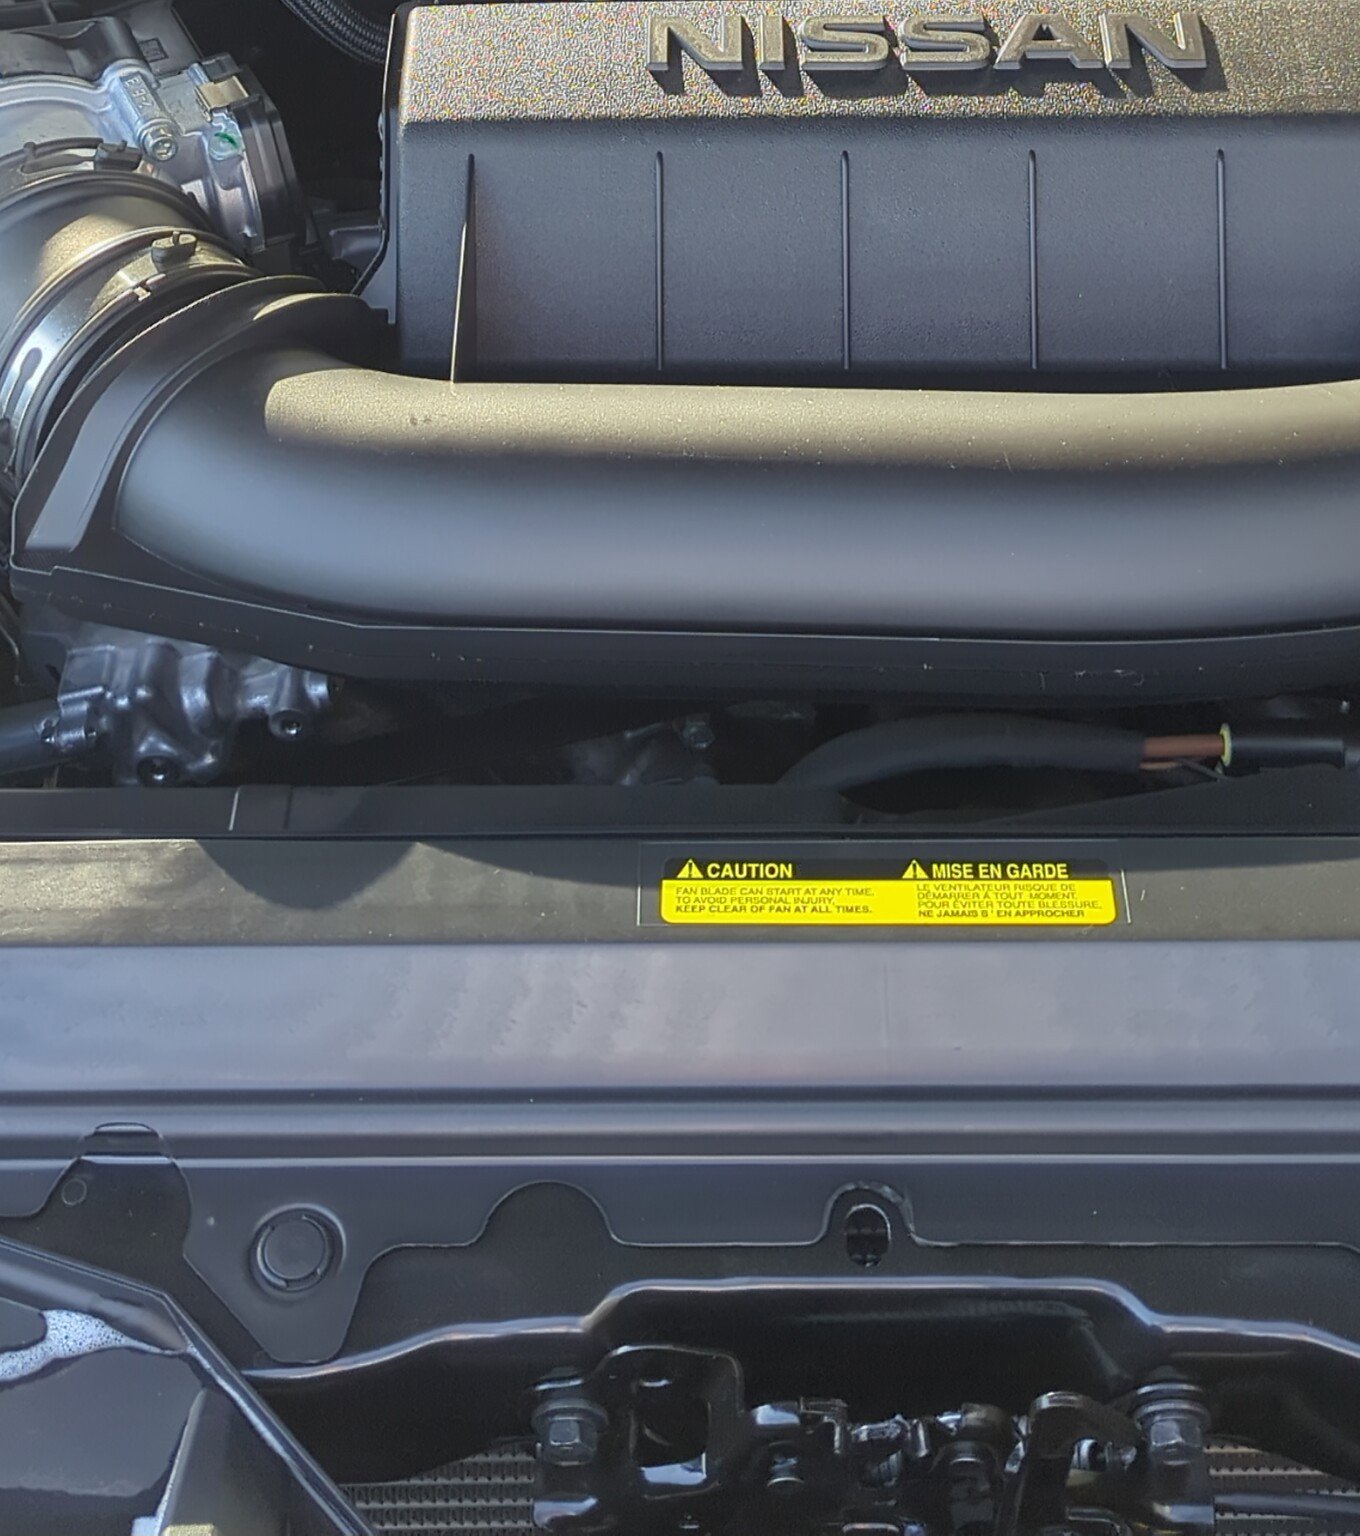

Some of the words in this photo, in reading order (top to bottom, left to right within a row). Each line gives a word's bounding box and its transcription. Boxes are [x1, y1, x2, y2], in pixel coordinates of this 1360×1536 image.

[646, 11, 1207, 70] NISSAN
[706, 863, 793, 879] CAUTION
[931, 863, 975, 879] MISE
[978, 863, 1002, 879] EN
[1006, 863, 1069, 879] GARDE
[675, 887, 697, 896] FAN
[700, 887, 737, 896] BLADE
[740, 887, 764, 896] CAN
[766, 887, 802, 896] START
[804, 887, 818, 896] AT
[819, 887, 843, 896] ANY
[916, 883, 931, 892] LE
[933, 883, 1011, 892] VENTILATEUR
[1013, 883, 1058, 892] RISQUE
[1059, 883, 1076, 892] DE
[675, 896, 691, 905] TO
[693, 896, 727, 905] AVOID
[730, 896, 790, 905] PERSONAL
[994, 892, 1023, 900] TOUT
[675, 905, 706, 913] KEEP
[708, 905, 747, 913] CLEAR
[750, 905, 765, 913] OF
[768, 905, 791, 913] FAN
[794, 905, 808, 913] AT
[811, 905, 832, 913] ALL
[835, 905, 873, 914] TIMES.
[918, 901, 950, 909] POUR
[996, 901, 1036, 909] TOUTE
[918, 910, 934, 918] NE
[936, 910, 979, 918] JAMAIS
[996, 910, 1015, 918] EN
[1016, 910, 1085, 918] APPROCHER
